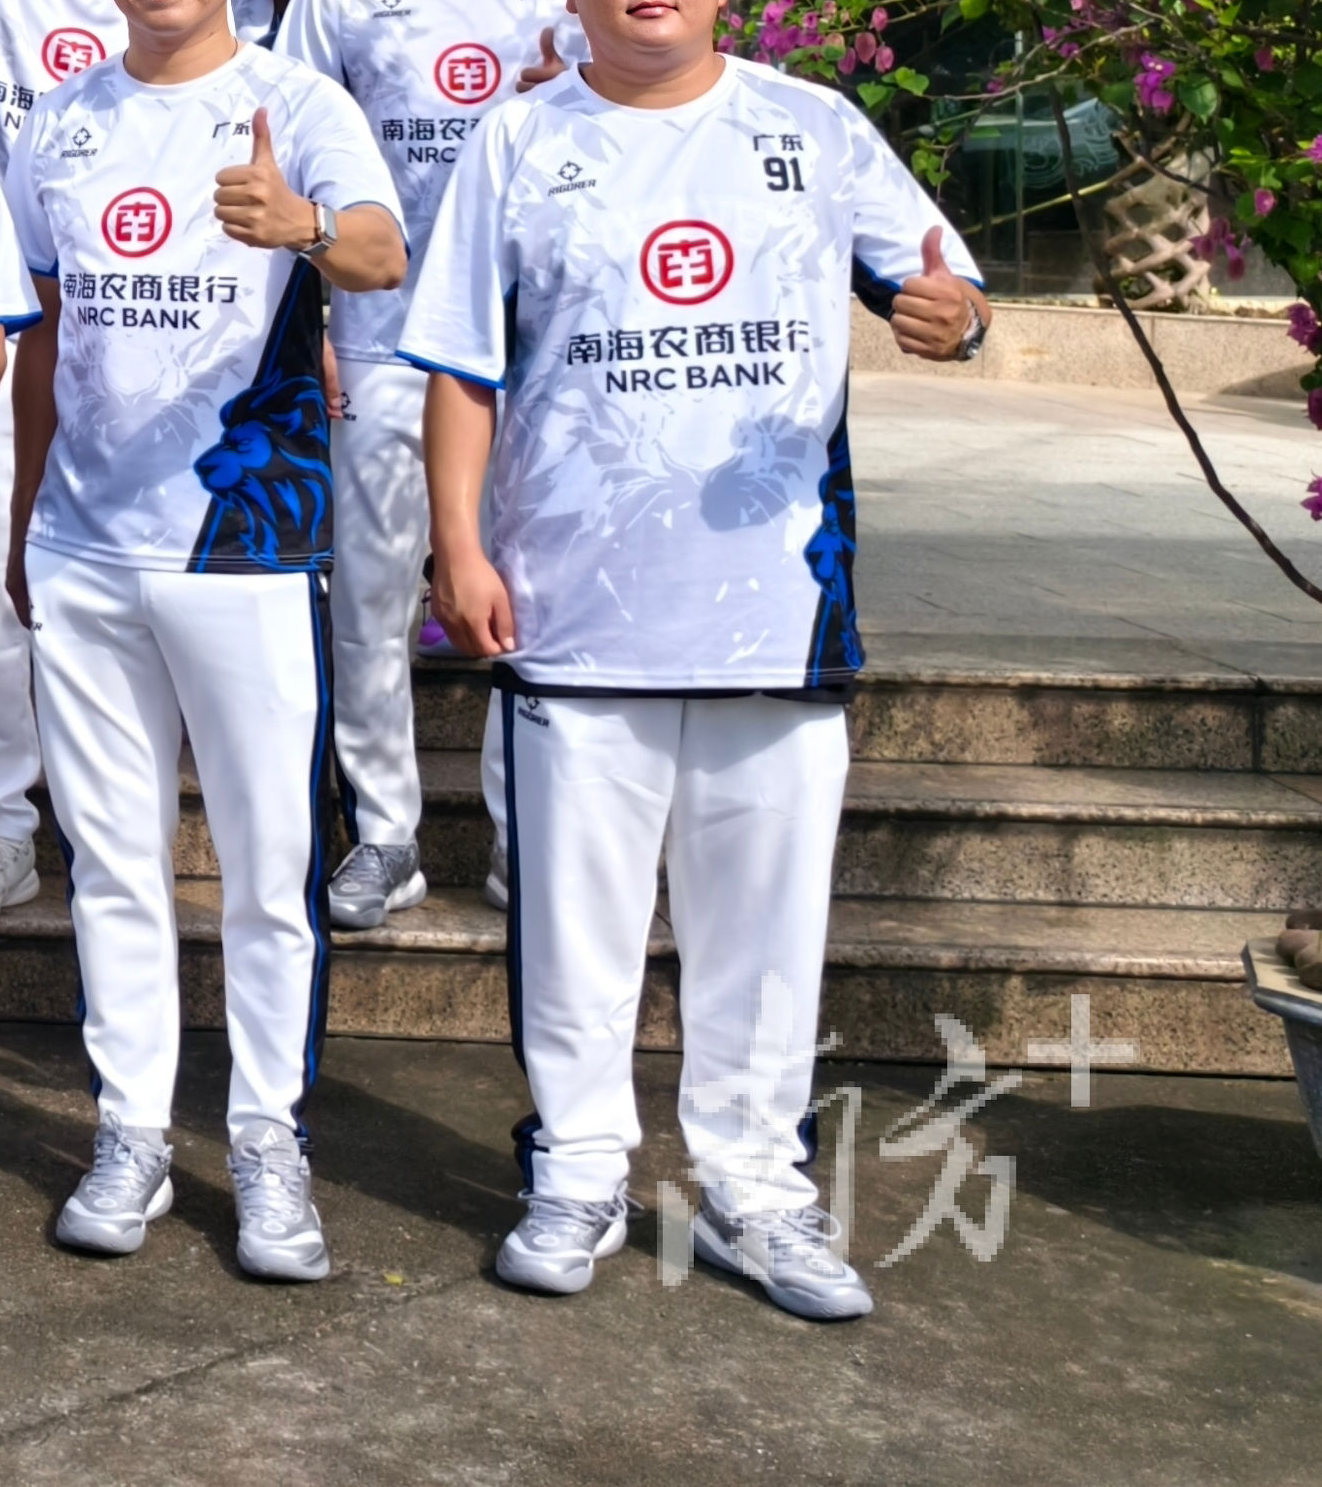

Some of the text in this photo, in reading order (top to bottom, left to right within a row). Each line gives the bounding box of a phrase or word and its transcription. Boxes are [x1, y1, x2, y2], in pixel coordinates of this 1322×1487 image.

[212, 119, 251, 138] 广东
[381, 117, 482, 142] 南海农
[752, 134, 804, 152] 广东
[407, 147, 456, 164] NRC
[763, 157, 805, 192] 91
[547, 179, 597, 197] RIGORER
[62, 272, 239, 304] 南海农商银行
[76, 306, 201, 330] NRC BANK
[565, 319, 810, 366] 南海农商银行
[605, 361, 786, 394] NRC BANK
